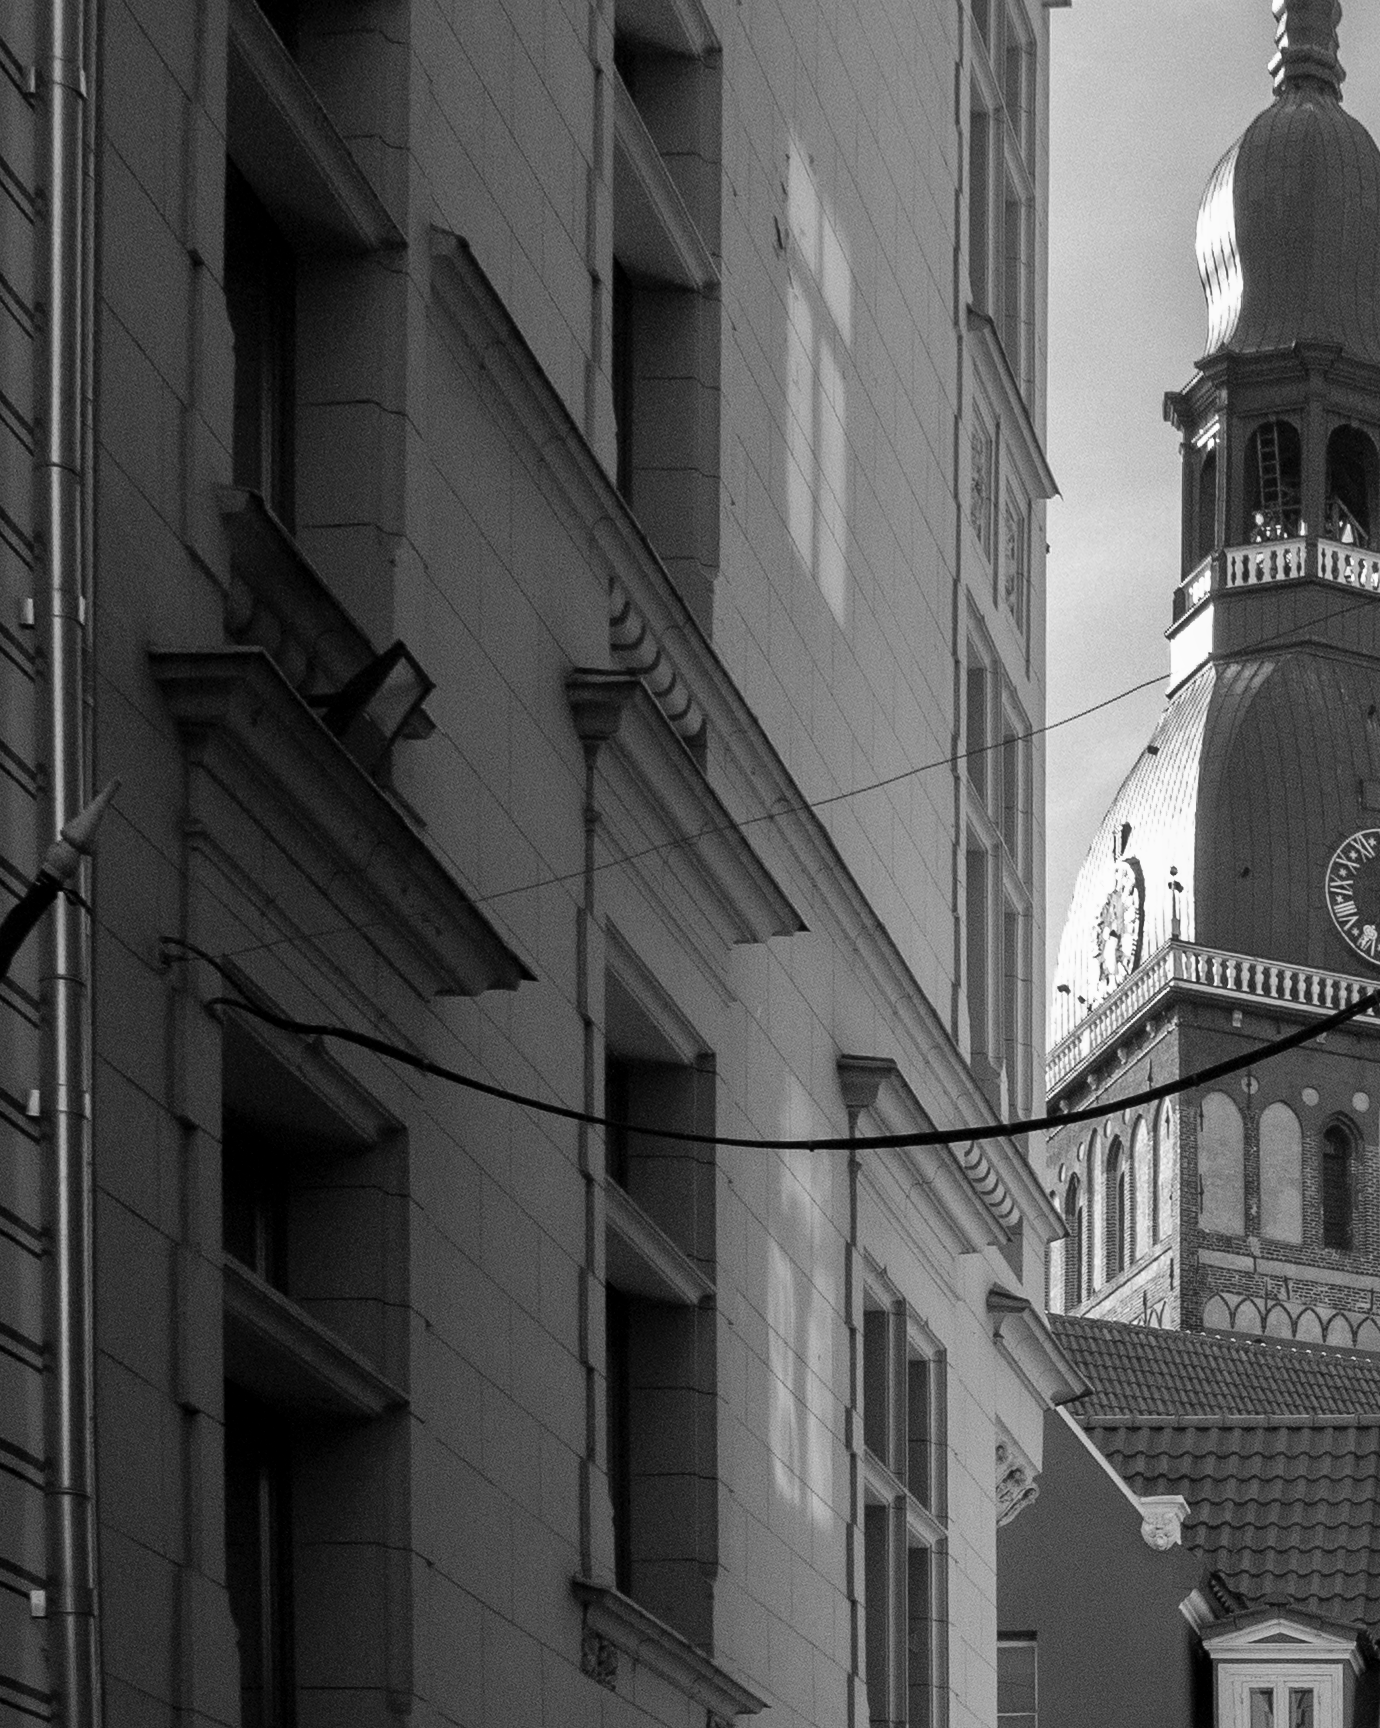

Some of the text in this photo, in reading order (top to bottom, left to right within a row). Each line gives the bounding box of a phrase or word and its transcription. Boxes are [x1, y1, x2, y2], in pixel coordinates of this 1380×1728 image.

[1350, 834, 1376, 862] XI
[1335, 851, 1360, 875] X
[1333, 900, 1359, 931] VIII
